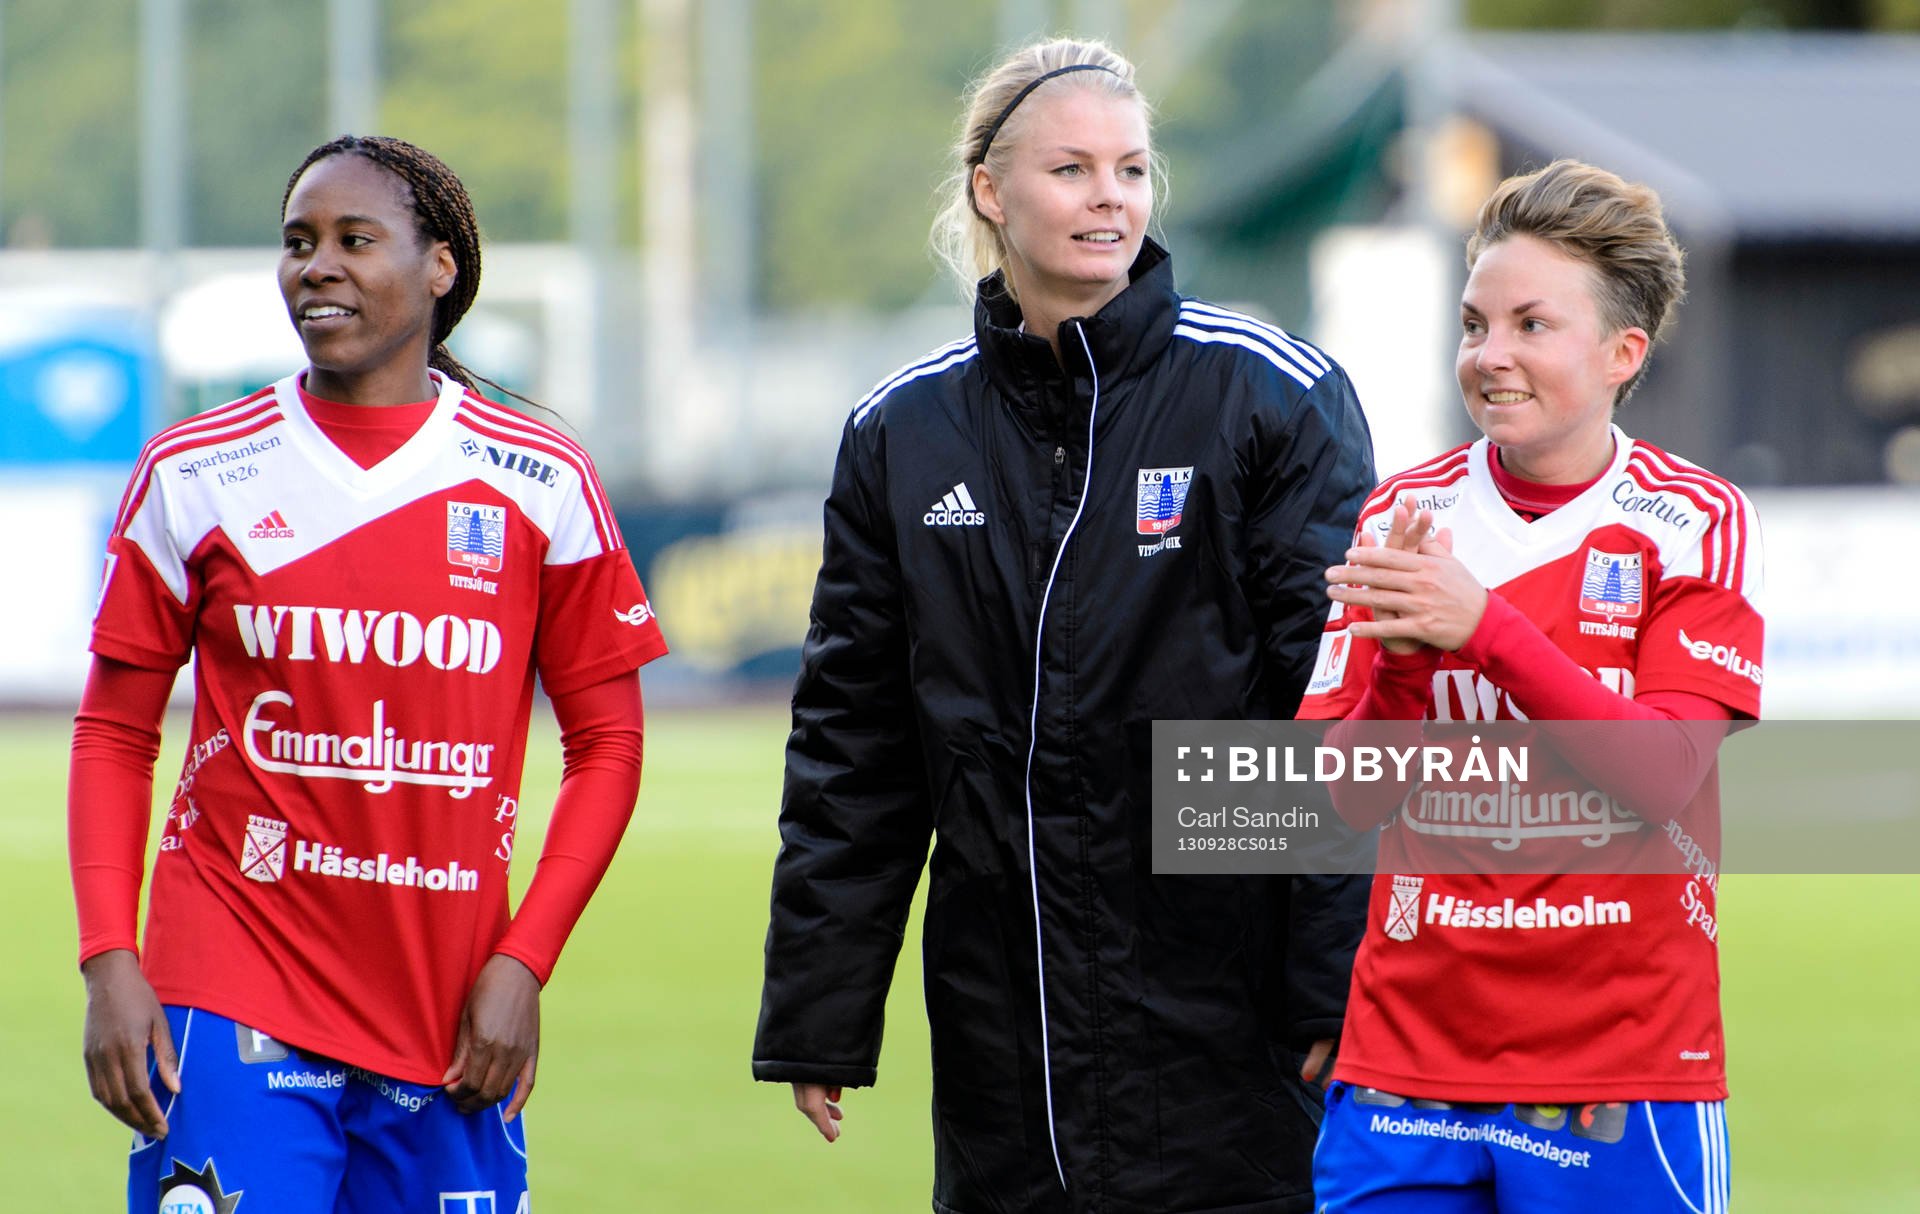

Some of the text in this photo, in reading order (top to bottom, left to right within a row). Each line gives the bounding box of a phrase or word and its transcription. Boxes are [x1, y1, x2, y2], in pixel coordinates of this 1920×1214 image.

[178, 436, 282, 480] Sparbanken
[217, 462, 259, 486] 1826
[481, 445, 560, 488] NIBE
[923, 508, 985, 526] adidas
[1612, 479, 1691, 530] Contua
[248, 527, 295, 540] adidas
[1165, 536, 1182, 549] GIK
[448, 574, 499, 595] VITTSJÖ GIK
[233, 604, 502, 675] WIWOOD
[1579, 620, 1638, 640] VITTSJÖ GIK
[1679, 628, 1763, 687] eolus
[243, 690, 494, 800] Emmaljunga
[294, 840, 479, 892] Hässleholm
[1425, 892, 1632, 930] Hässleholm
[1480, 1123, 1592, 1168] Aktiebolaget
